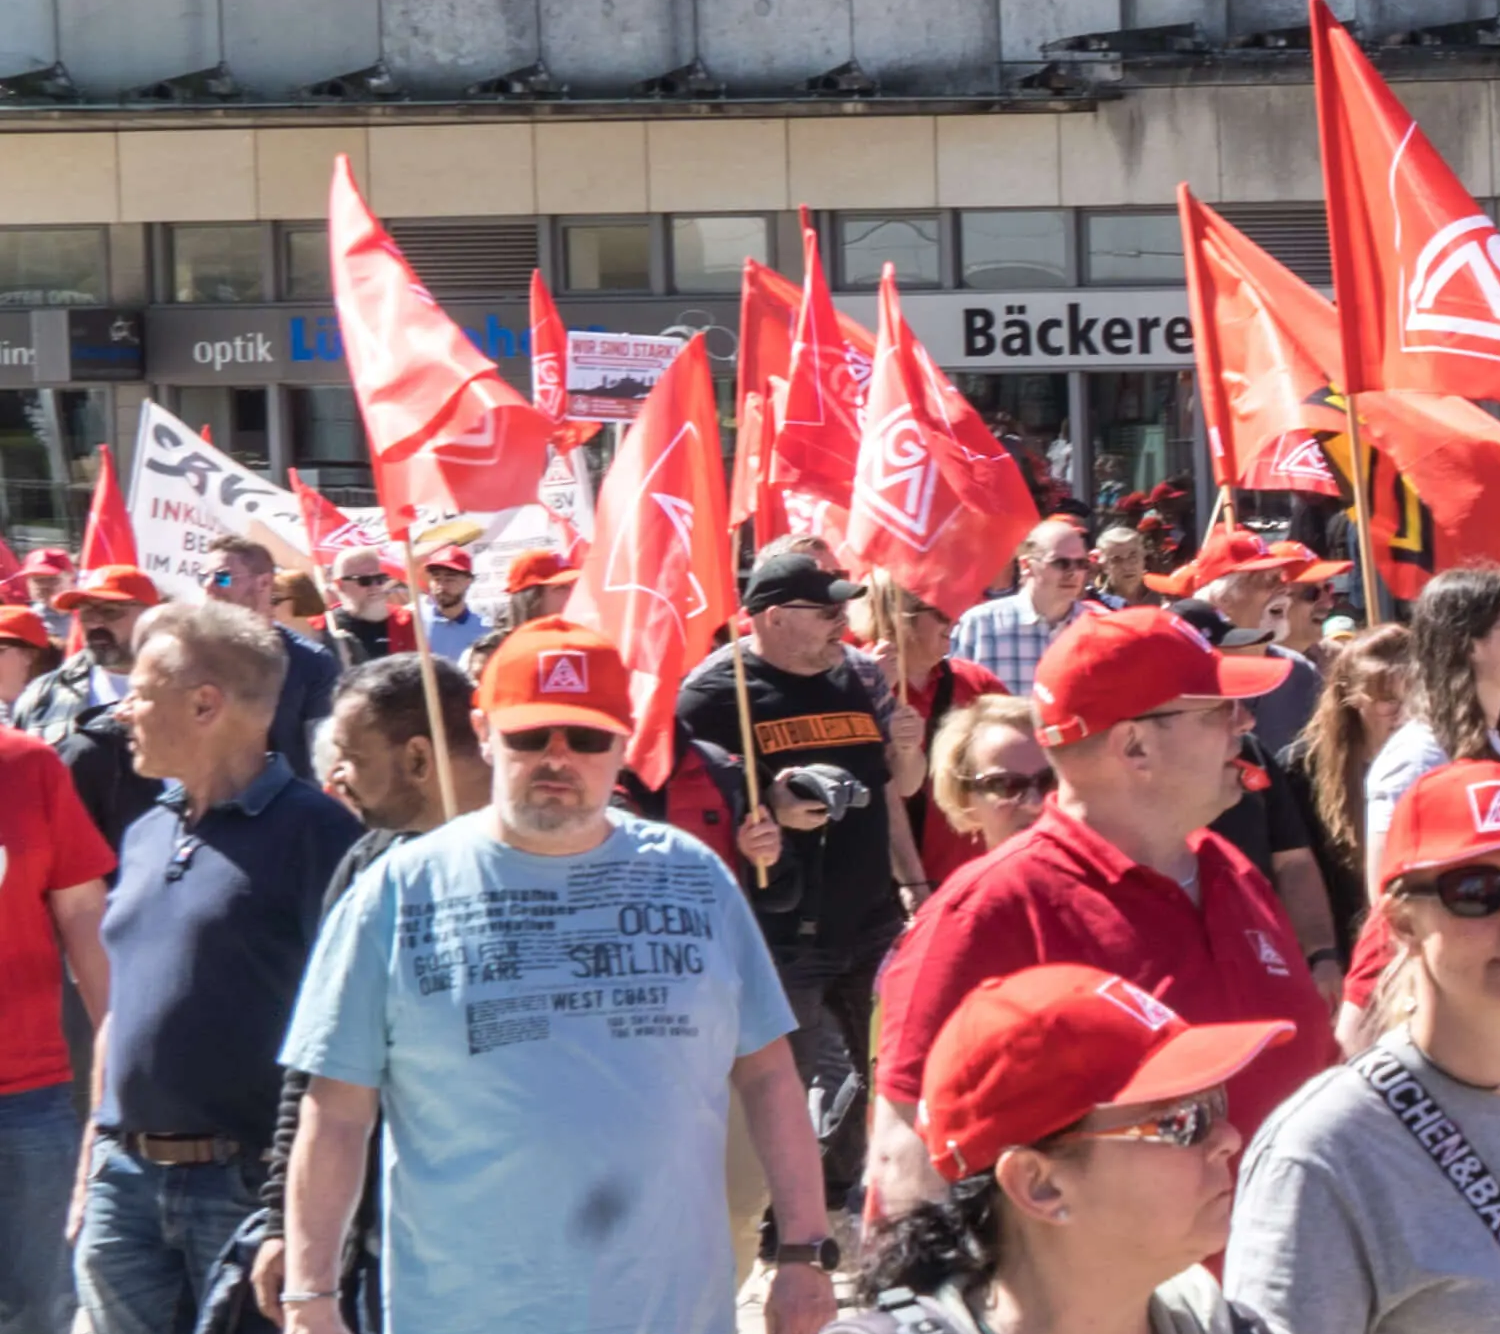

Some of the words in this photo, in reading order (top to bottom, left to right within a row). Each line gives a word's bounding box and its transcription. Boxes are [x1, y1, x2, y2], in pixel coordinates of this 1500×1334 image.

[572, 339, 596, 354] WIR
[600, 341, 628, 357] SIND
[964, 302, 1193, 358] Bäckere
[193, 333, 274, 371] optik
[618, 904, 714, 941] OCEAN
[553, 989, 604, 1011] WEST
[612, 986, 669, 1007] COAST
